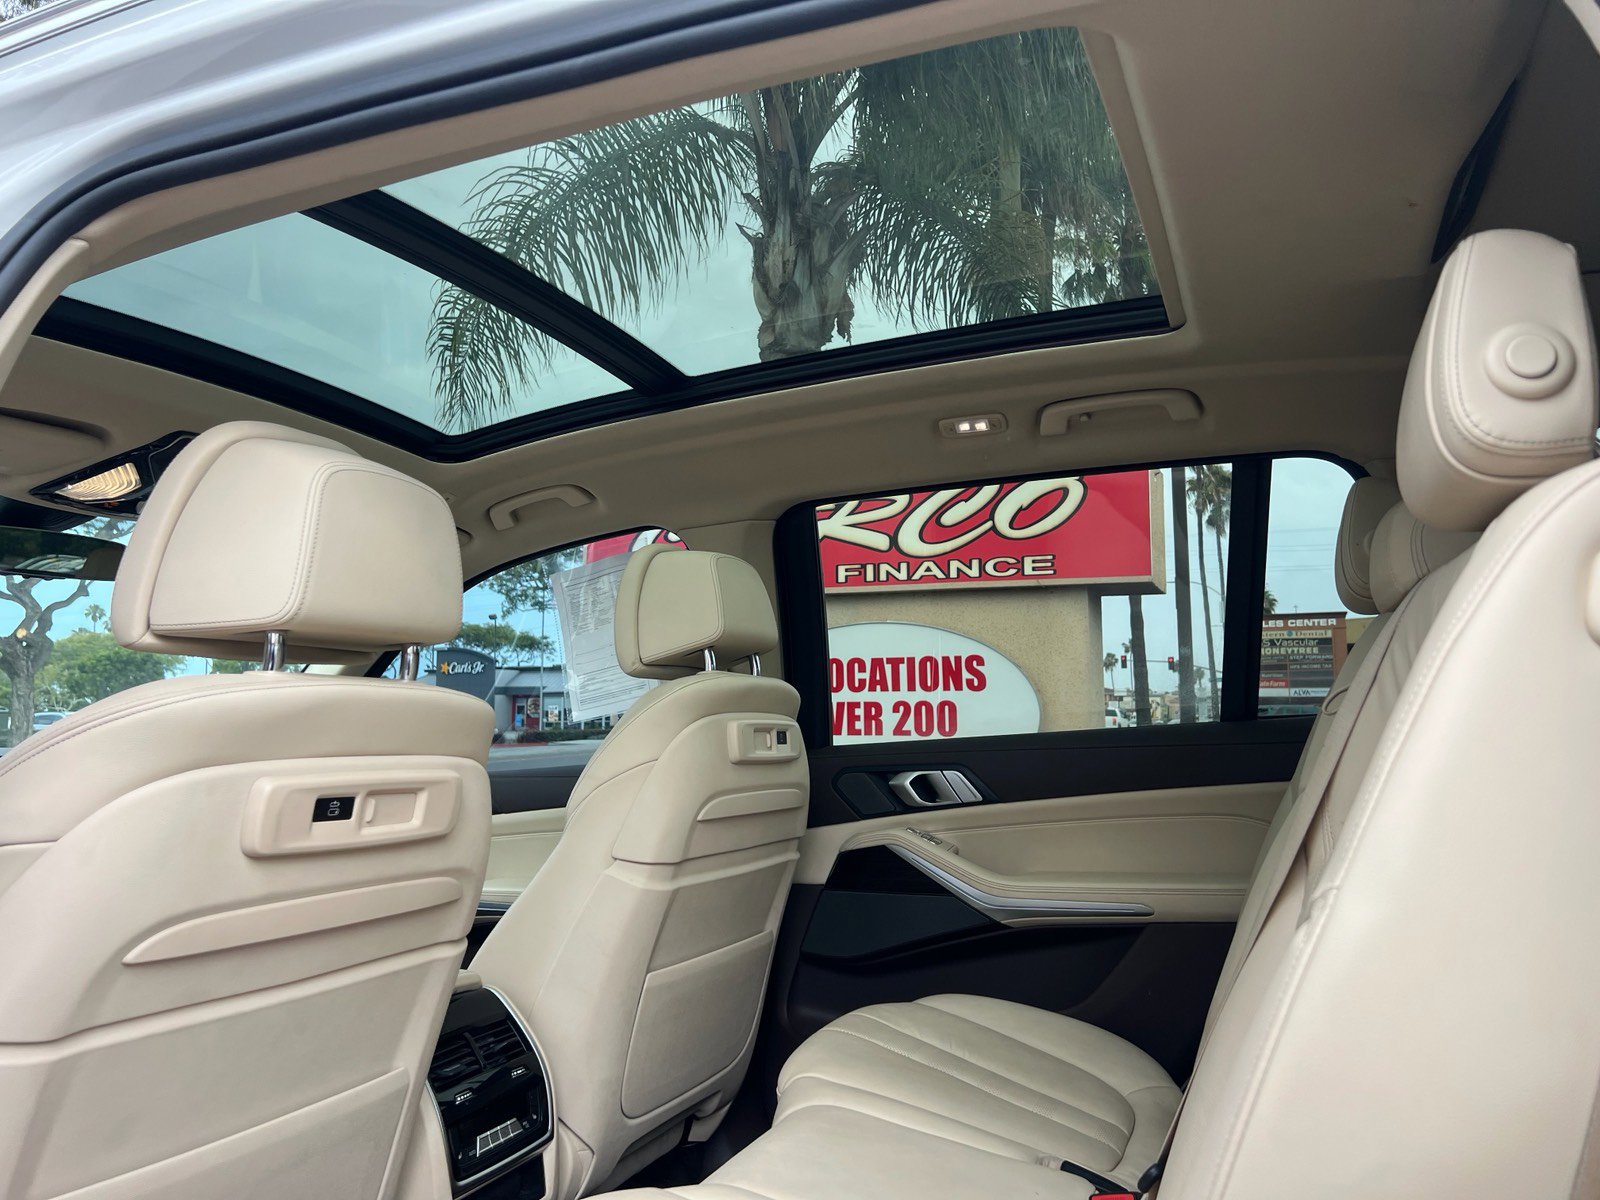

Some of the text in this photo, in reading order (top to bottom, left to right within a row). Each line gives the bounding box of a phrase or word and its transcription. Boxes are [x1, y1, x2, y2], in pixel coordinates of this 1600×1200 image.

[836, 555, 1057, 584] FINANCE
[1288, 618, 1337, 627] CENTER
[1296, 629, 1328, 637] Dental
[1275, 639, 1318, 647] Vascular
[449, 662, 472, 675] Carl's
[829, 654, 987, 694] OCATIONS
[1293, 688, 1311, 696] ALVA
[832, 700, 958, 737] VER 200
